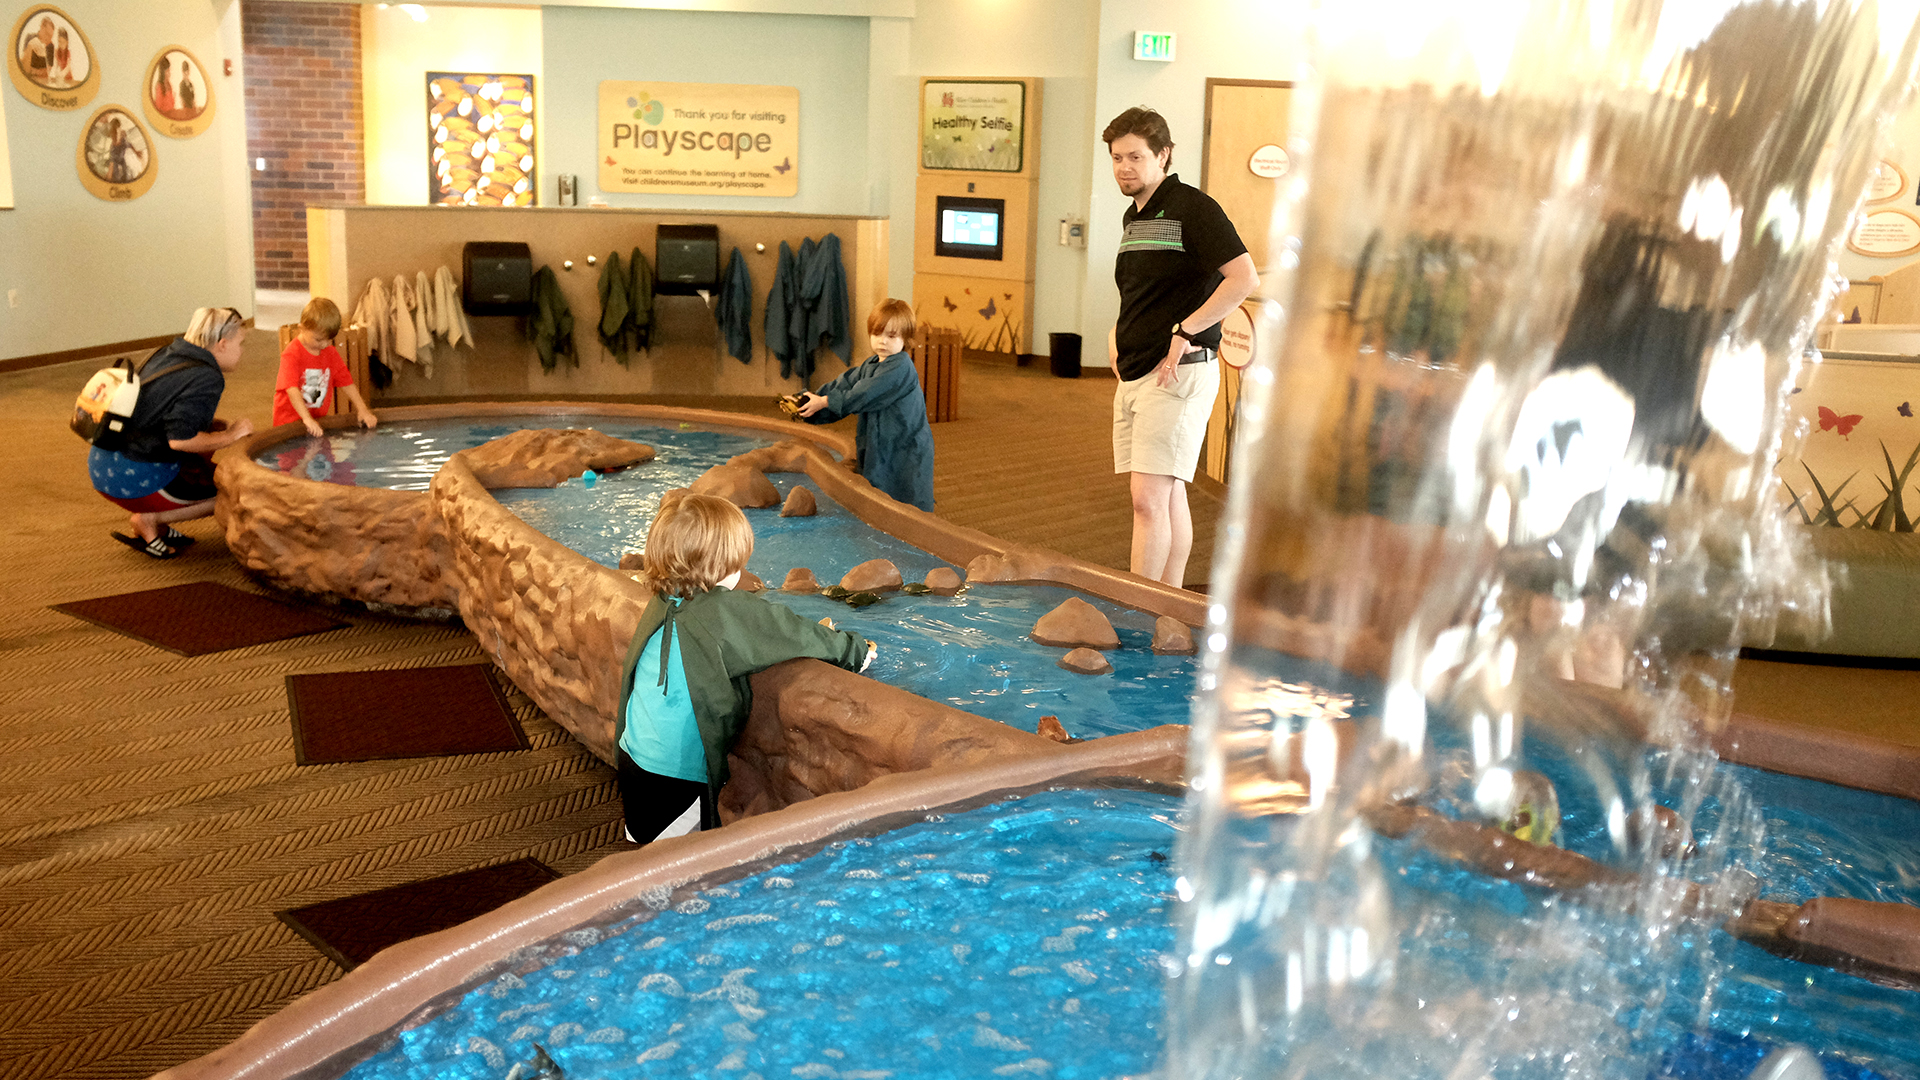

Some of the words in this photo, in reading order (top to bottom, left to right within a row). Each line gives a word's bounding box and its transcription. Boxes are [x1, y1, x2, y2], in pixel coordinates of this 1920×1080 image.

[1141, 34, 1171, 58] EXIT
[41, 92, 78, 108] Discover
[673, 108, 705, 119] Thank
[708, 111, 729, 122] you
[731, 109, 746, 120] for
[749, 110, 786, 124] visiting
[932, 115, 977, 131] Healthy
[980, 116, 1013, 131] Selfie
[612, 123, 772, 160] Playscape
[654, 168, 687, 176] continue
[109, 186, 132, 199] Climb
